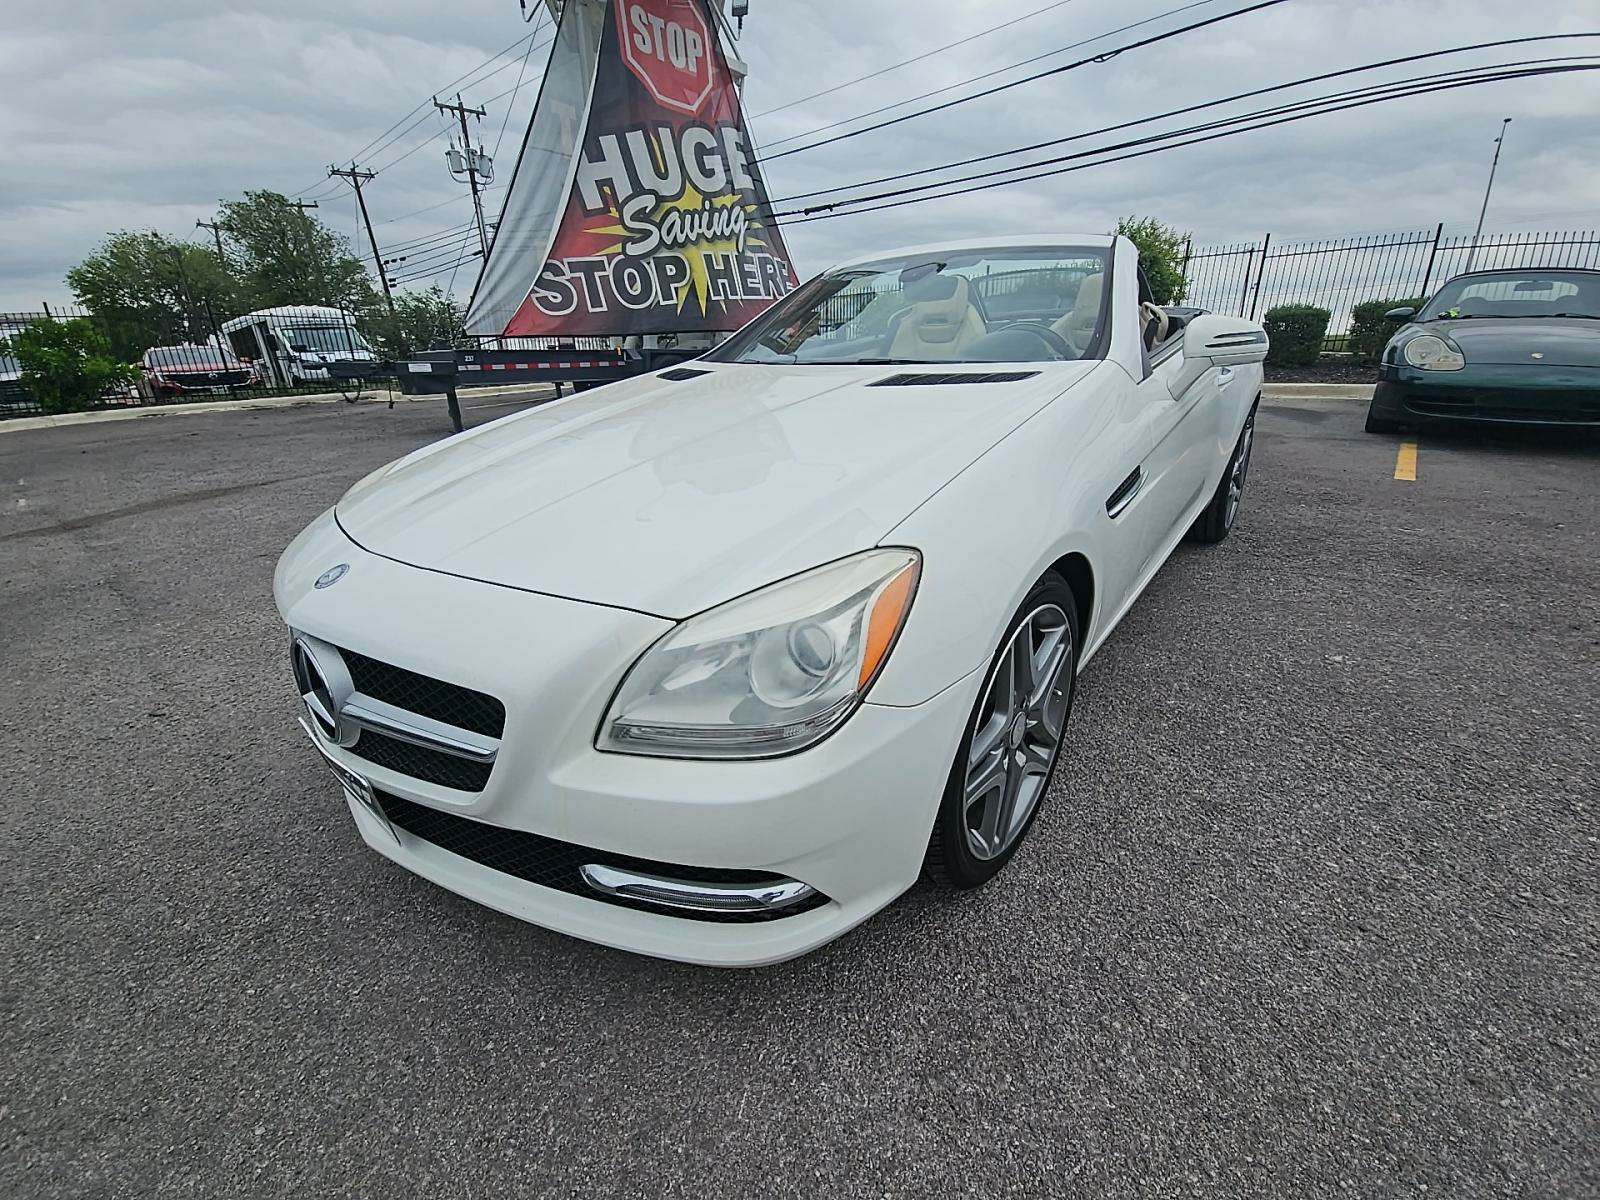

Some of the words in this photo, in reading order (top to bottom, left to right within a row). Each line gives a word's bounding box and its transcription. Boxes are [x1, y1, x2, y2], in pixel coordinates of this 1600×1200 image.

[630, 4, 703, 73] STOP
[577, 127, 755, 210] HUGE
[623, 194, 748, 256] Saving
[530, 254, 691, 316] STOP
[702, 251, 795, 300] HERE
